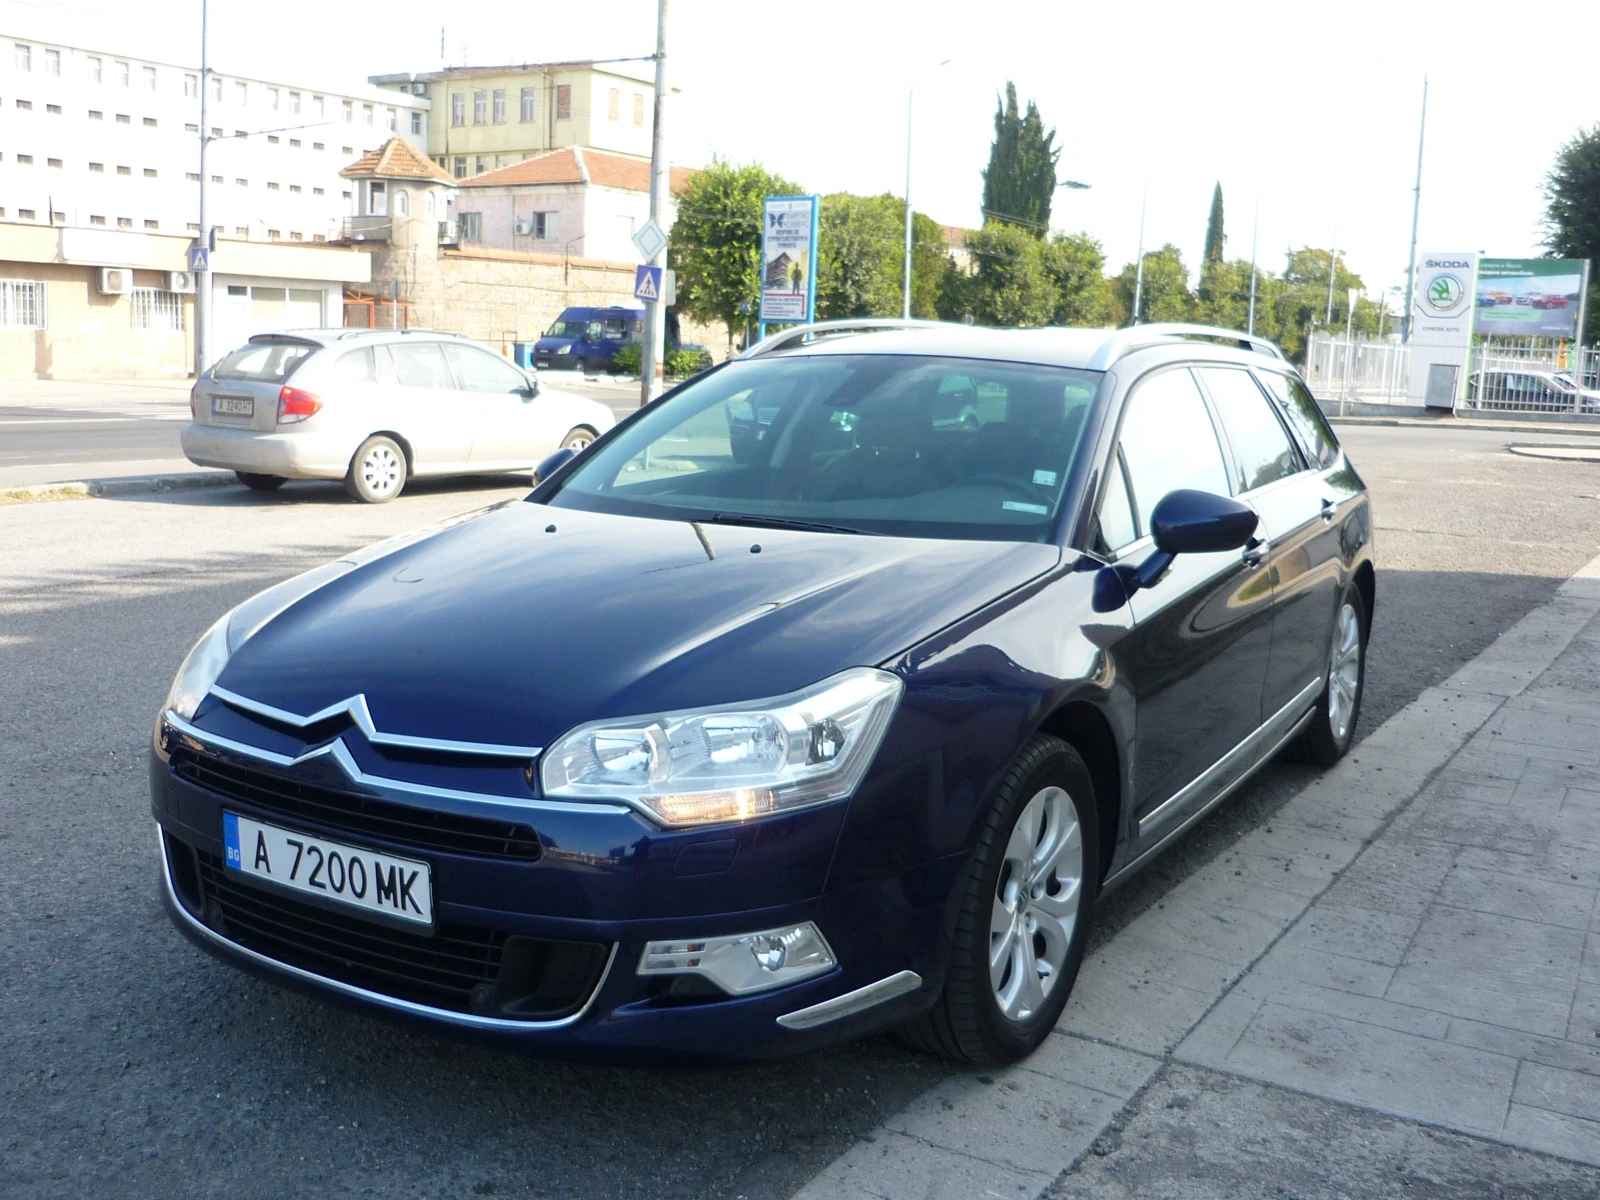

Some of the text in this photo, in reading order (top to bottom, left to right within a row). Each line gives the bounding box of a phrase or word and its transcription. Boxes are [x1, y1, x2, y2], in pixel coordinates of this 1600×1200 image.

[1425, 259, 1470, 268] ŠKODA
[219, 400, 224, 411] A
[228, 846, 240, 861] BG
[254, 829, 424, 914] A 7200 MK
